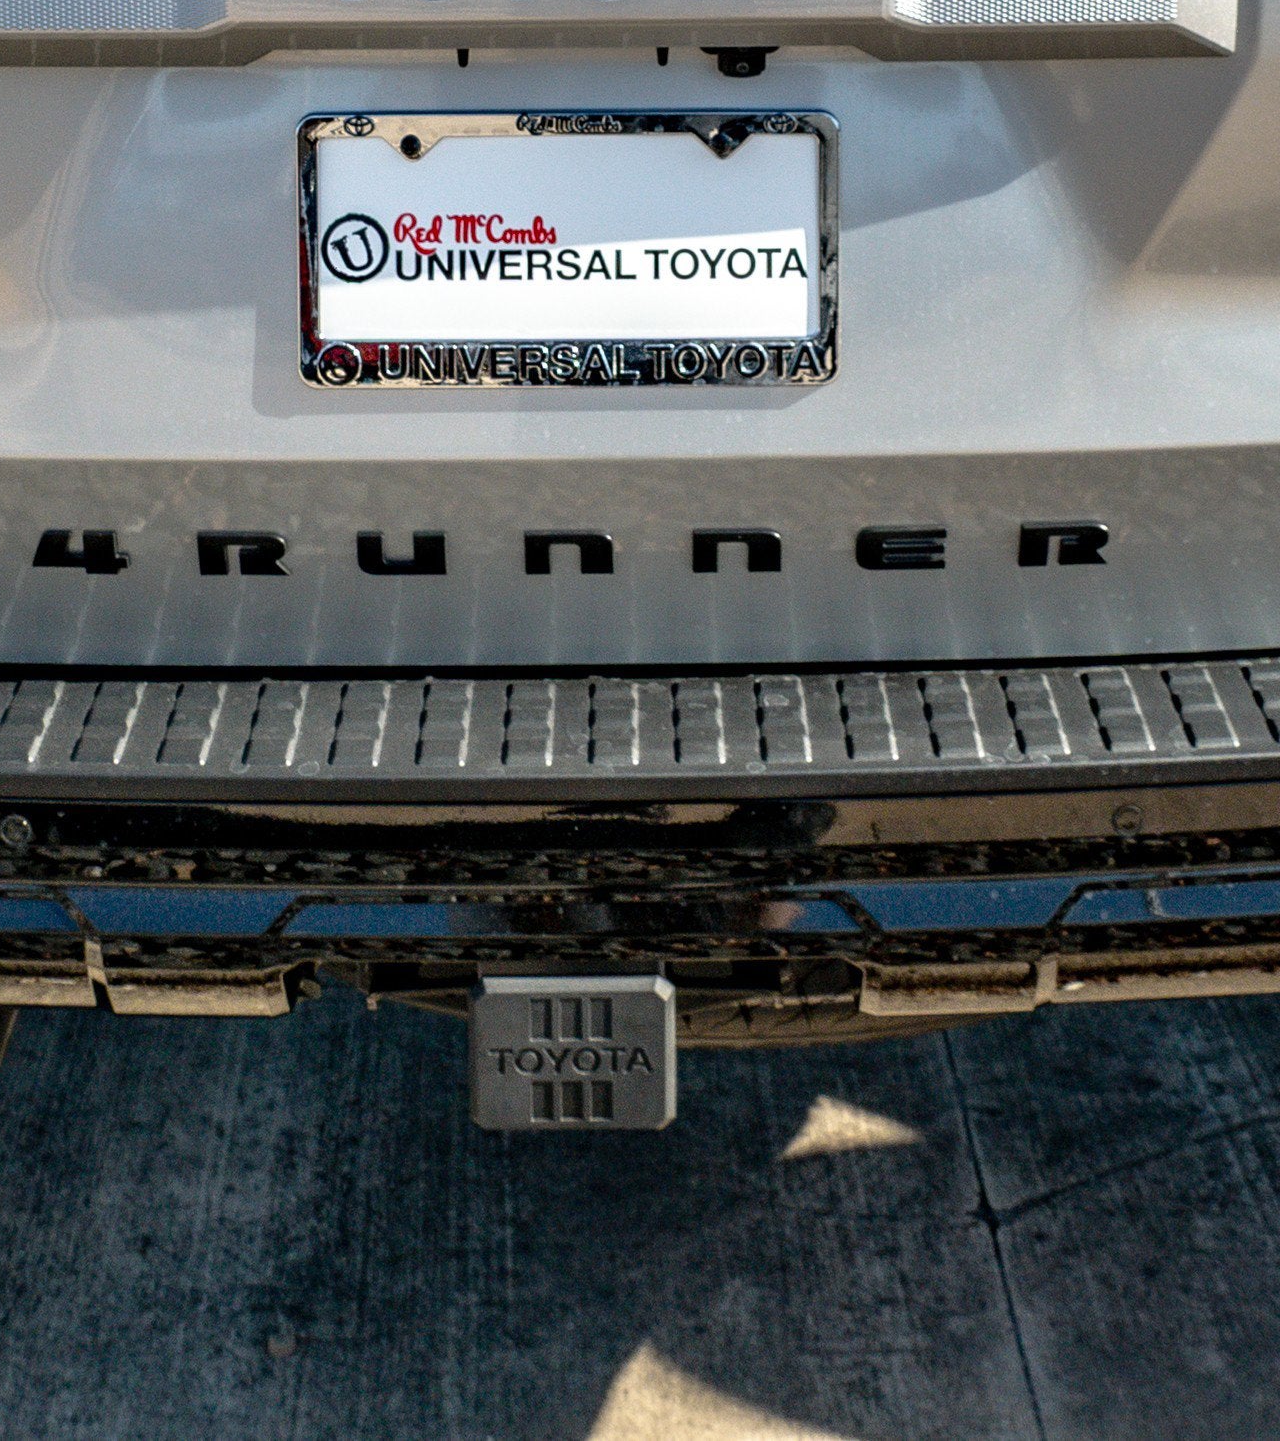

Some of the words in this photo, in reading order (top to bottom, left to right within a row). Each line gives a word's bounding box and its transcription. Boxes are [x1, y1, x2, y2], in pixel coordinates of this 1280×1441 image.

[393, 212, 443, 255] Red
[446, 214, 557, 245] McCombs
[395, 248, 637, 281] UNIVERSAL
[644, 247, 808, 280] TOYOTA
[378, 343, 640, 383] UNIVERSAL
[644, 341, 821, 381] TOYOTA
[32, 519, 1110, 576] 4RUNNER
[488, 1046, 654, 1077] TOYOTA
